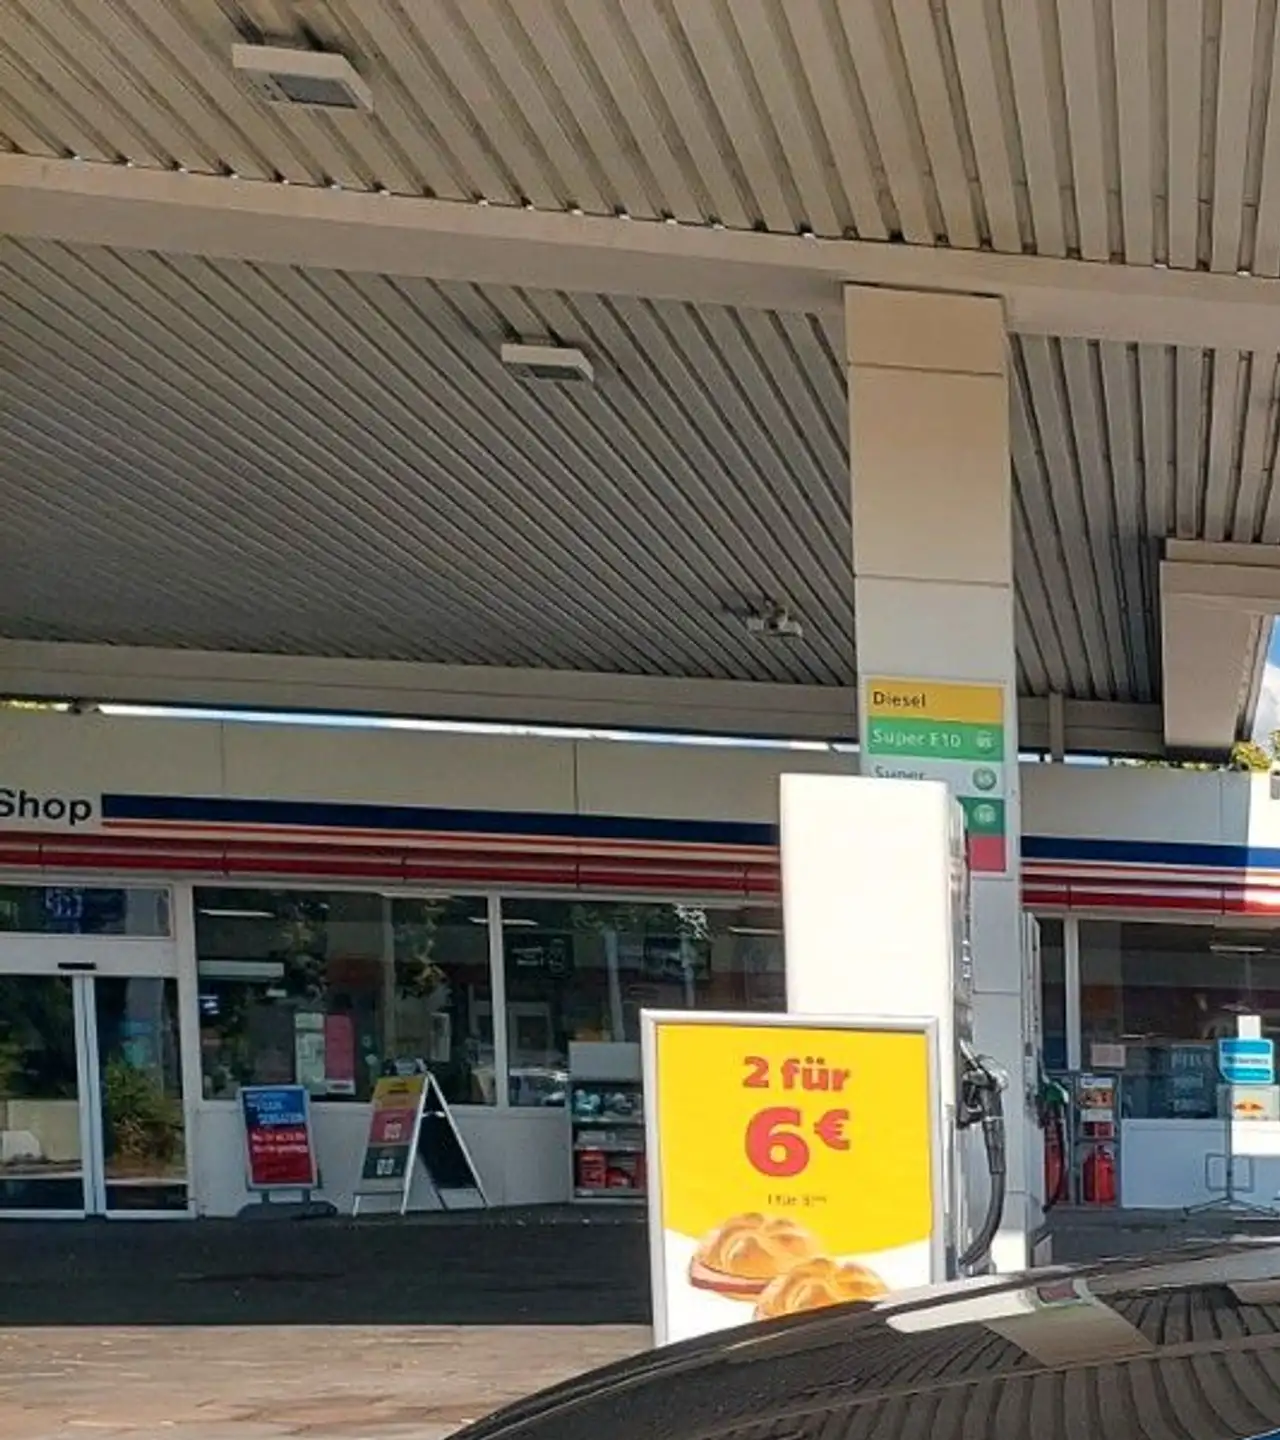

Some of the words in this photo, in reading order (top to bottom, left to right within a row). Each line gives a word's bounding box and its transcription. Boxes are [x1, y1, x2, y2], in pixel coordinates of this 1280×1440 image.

[873, 691, 926, 708] Diesel
[872, 729, 926, 748] Super
[0, 787, 92, 827] Shop
[743, 1056, 769, 1088] 2
[781, 1056, 851, 1091] für
